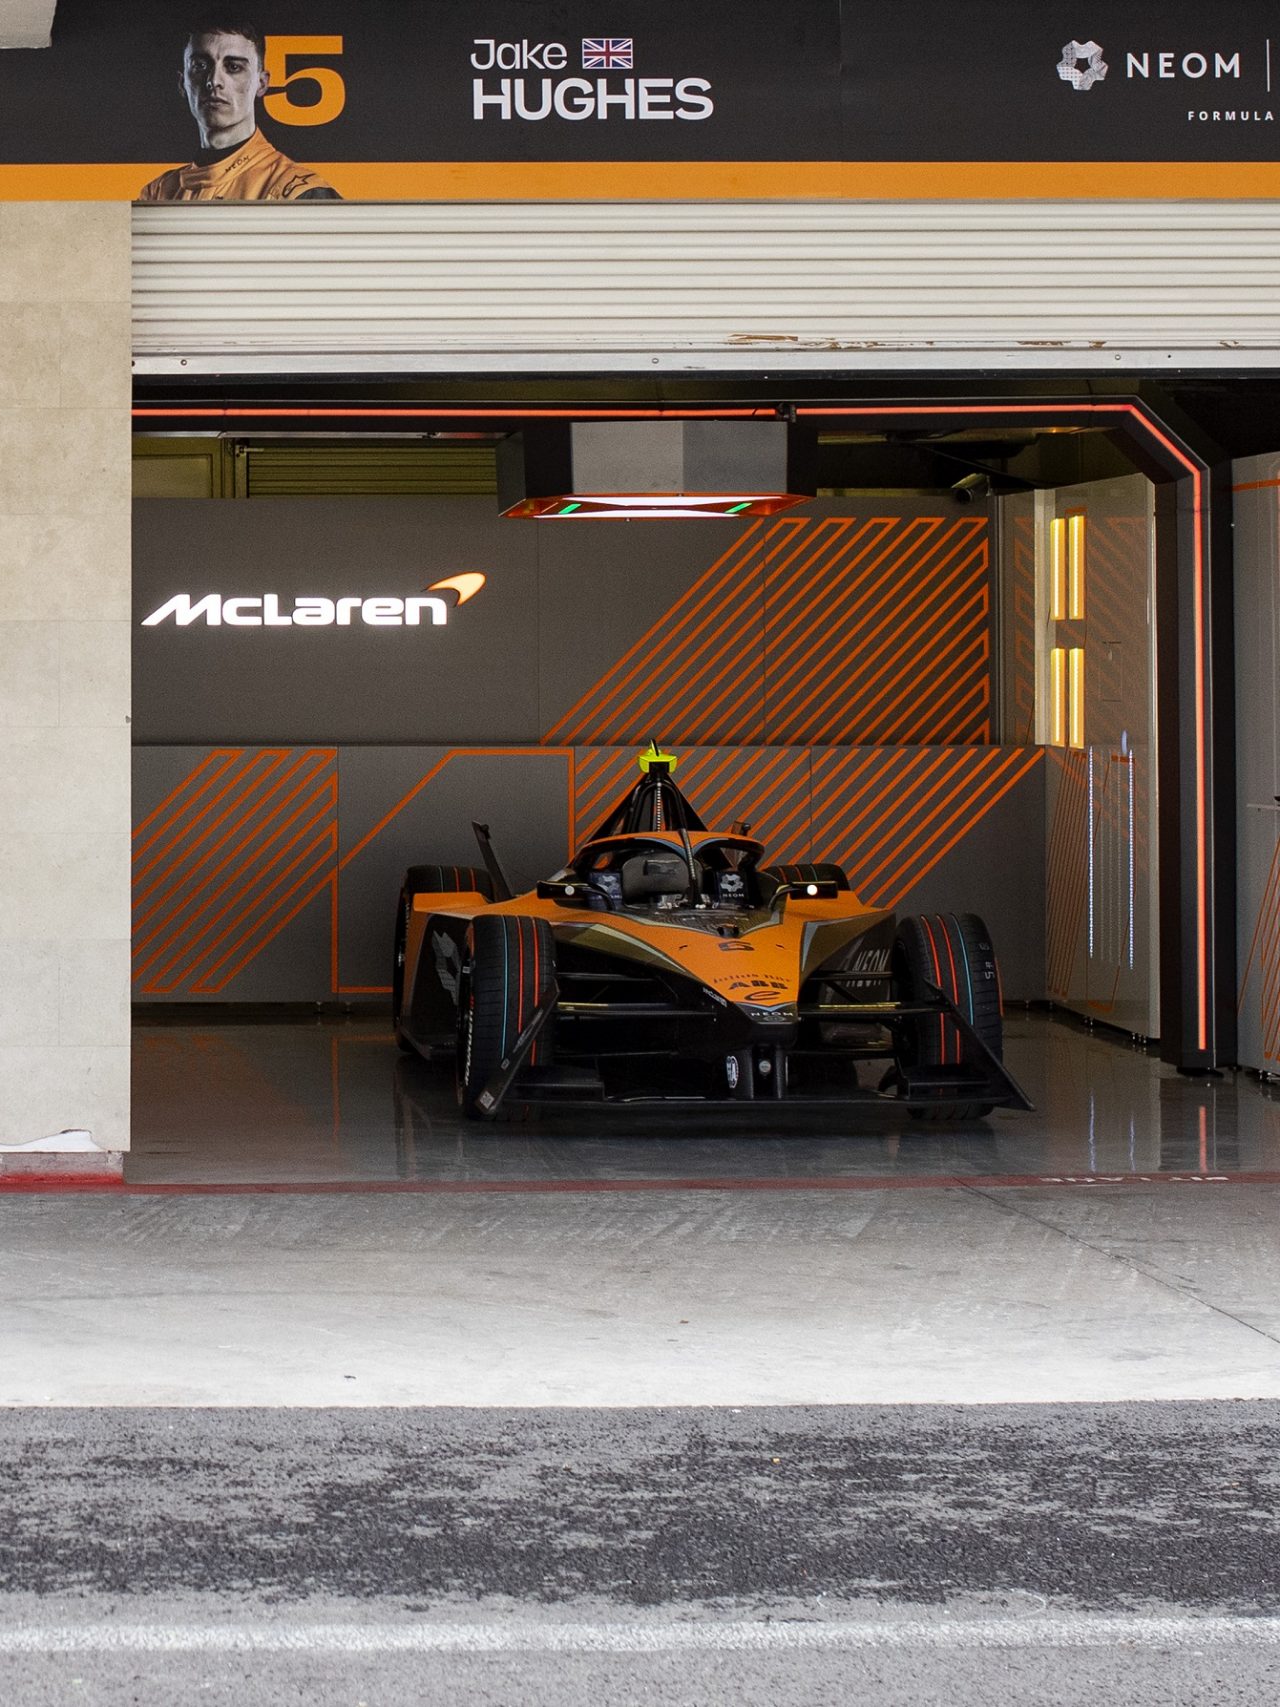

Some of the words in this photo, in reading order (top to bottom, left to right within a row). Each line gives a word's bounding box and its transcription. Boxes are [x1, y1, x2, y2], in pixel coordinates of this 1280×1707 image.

[471, 39, 568, 70] Jake
[1126, 52, 1241, 79] NEOM
[262, 35, 346, 127] 5
[472, 78, 714, 120] HUGHES
[1187, 110, 1274, 121] FORMULA
[141, 594, 448, 626] McLaren
